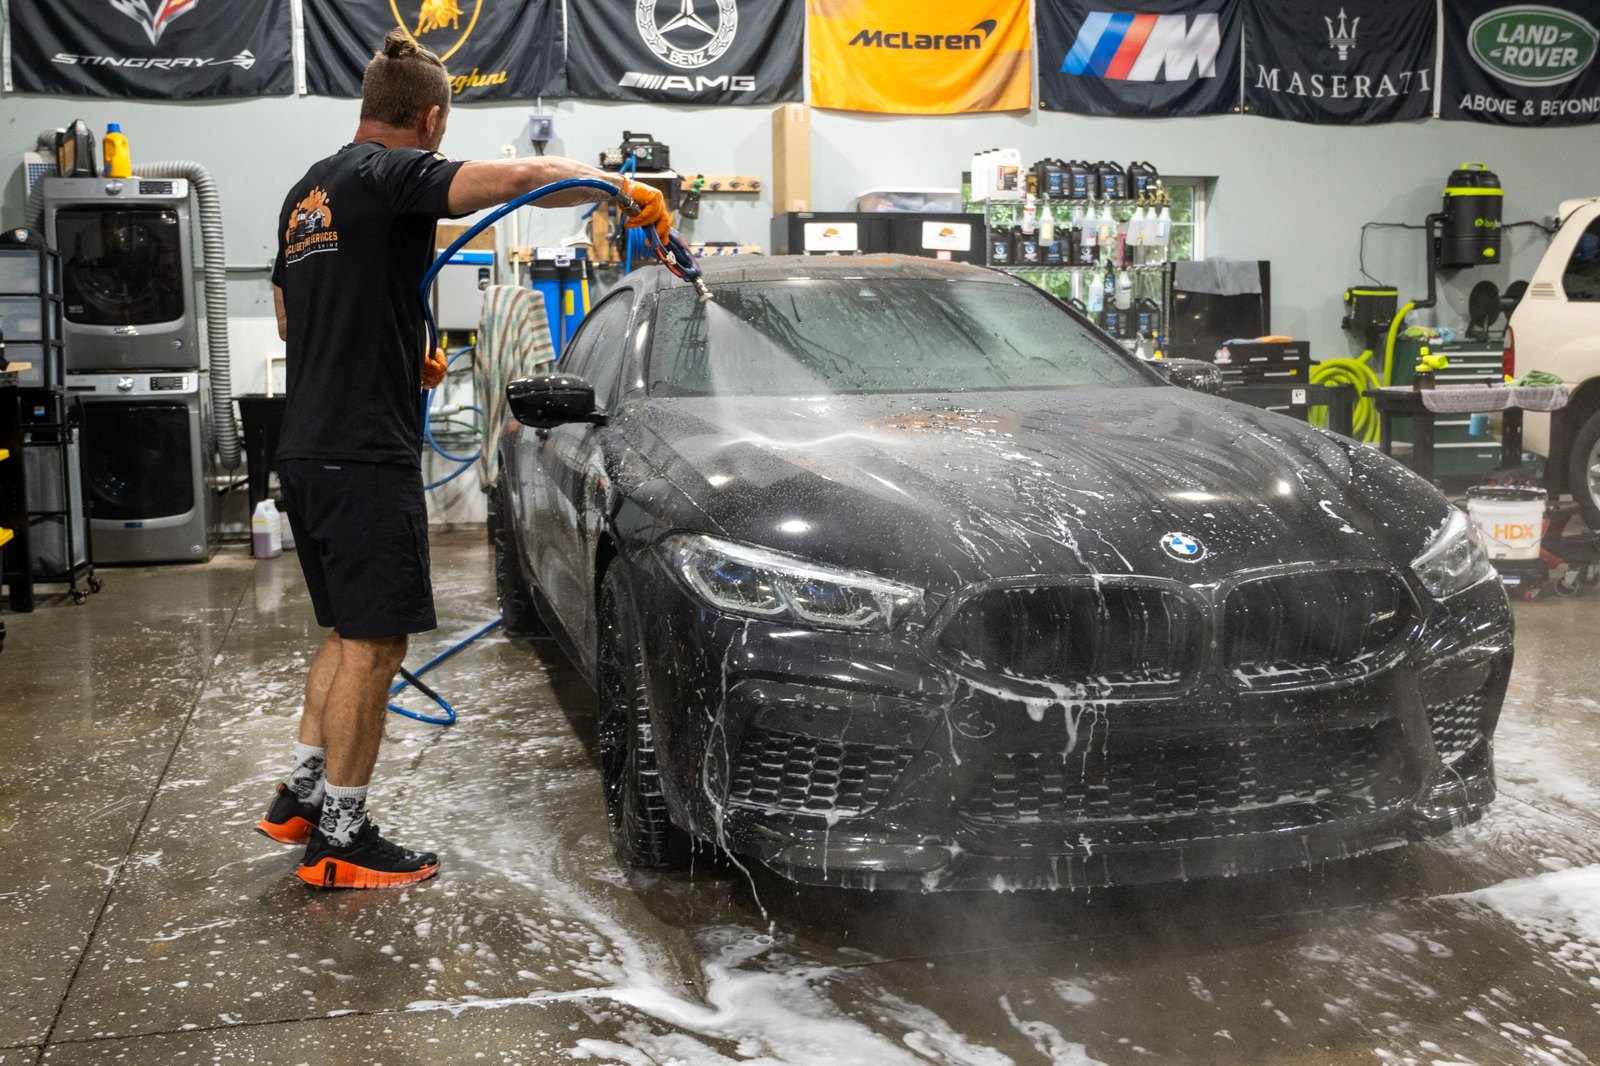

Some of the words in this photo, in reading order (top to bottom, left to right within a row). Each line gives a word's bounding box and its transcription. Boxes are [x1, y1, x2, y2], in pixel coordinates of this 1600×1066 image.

[848, 29, 981, 50] McLaren
[51, 53, 215, 70] STINGRAY
[669, 50, 708, 65] BENZ
[1502, 45, 1579, 67] ROVER
[661, 75, 756, 92] AMG
[1254, 64, 1432, 98] MASERATI
[1459, 94, 1517, 115] ABOVE
[1522, 100, 1534, 116] &
[1540, 96, 1600, 116] BEYOND
[1493, 523, 1536, 540] HDX
